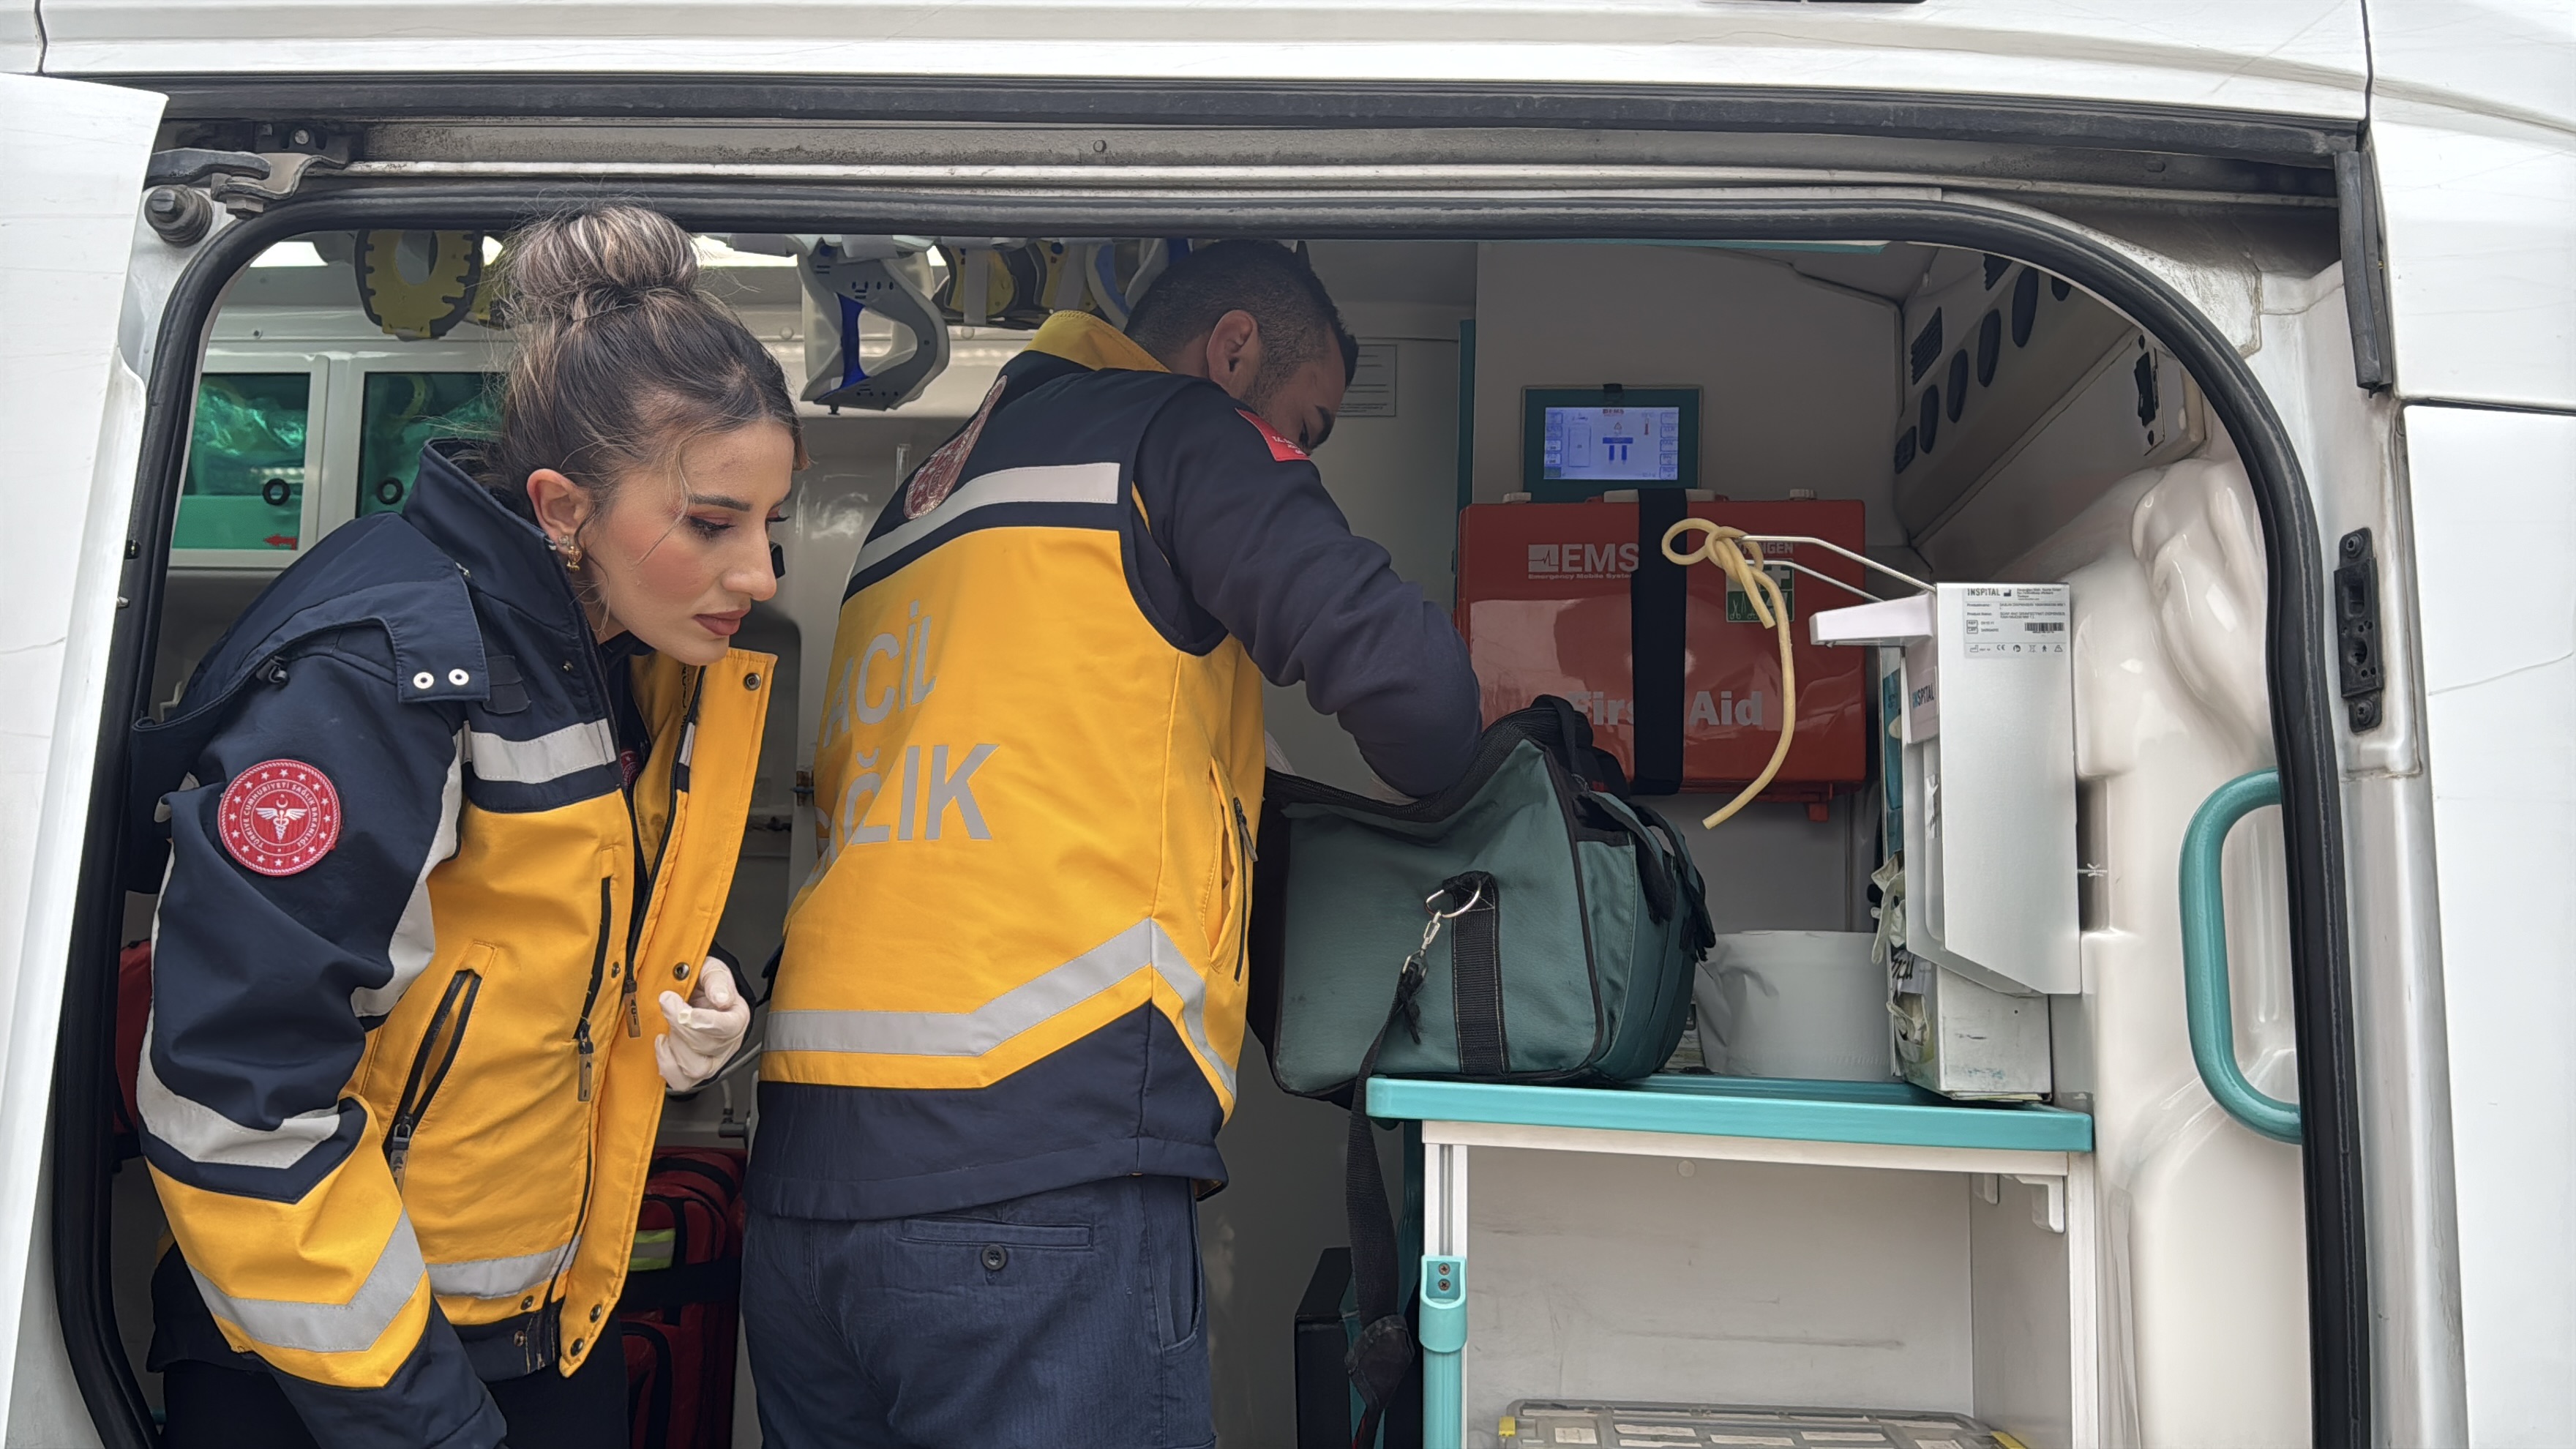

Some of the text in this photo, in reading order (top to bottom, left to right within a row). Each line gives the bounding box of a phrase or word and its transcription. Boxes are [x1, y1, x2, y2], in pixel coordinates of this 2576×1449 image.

[1562, 543, 1639, 572] EMS
[1967, 588, 2001, 596] INSPITAL
[822, 600, 937, 748] ACİL
[1568, 691, 1764, 727] Fir Aid
[243, 782, 290, 816] CUMHURİYETİ
[291, 783, 315, 806] SAĞLIK
